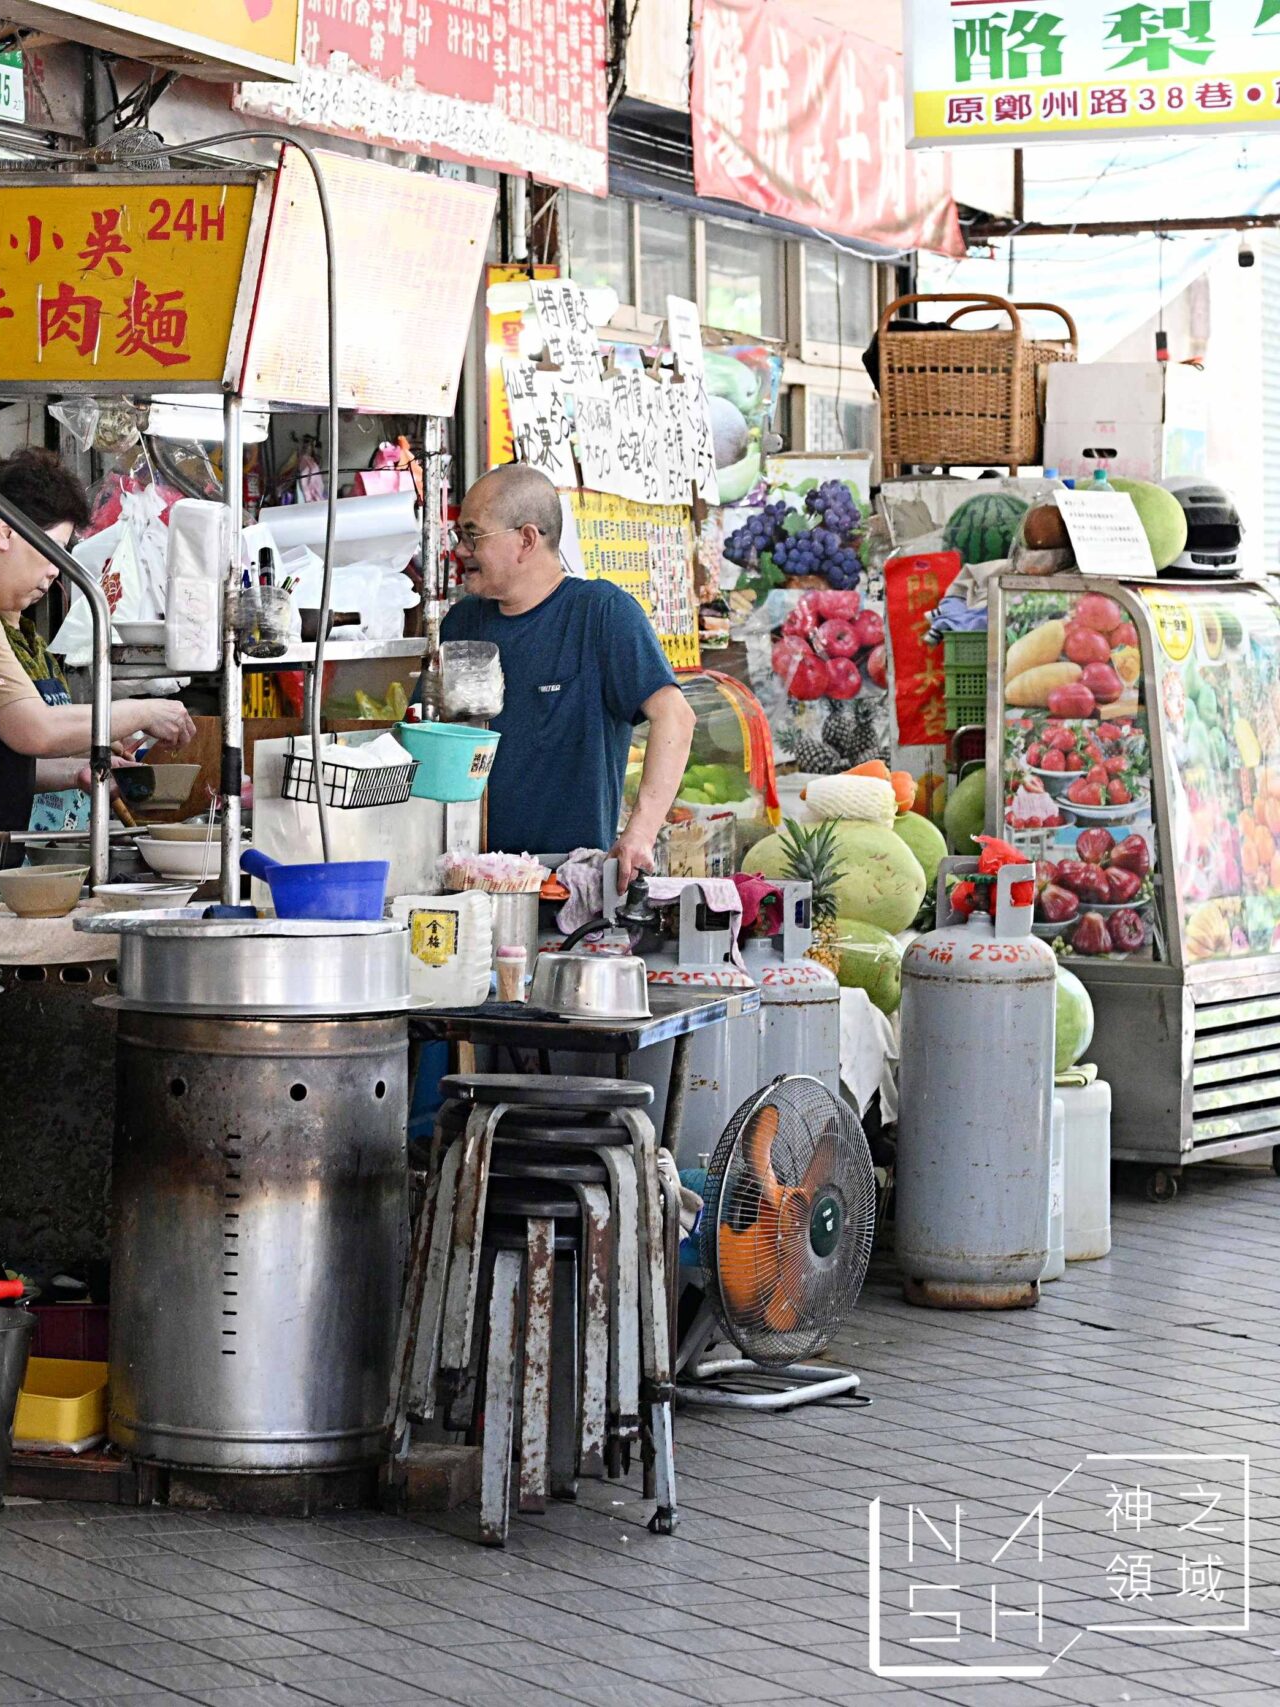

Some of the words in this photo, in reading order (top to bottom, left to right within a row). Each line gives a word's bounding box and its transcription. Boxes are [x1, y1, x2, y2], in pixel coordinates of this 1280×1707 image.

[952, 0, 1280, 82] 酪梨
[10, 208, 133, 277] 小吳
[148, 198, 225, 241] 24H
